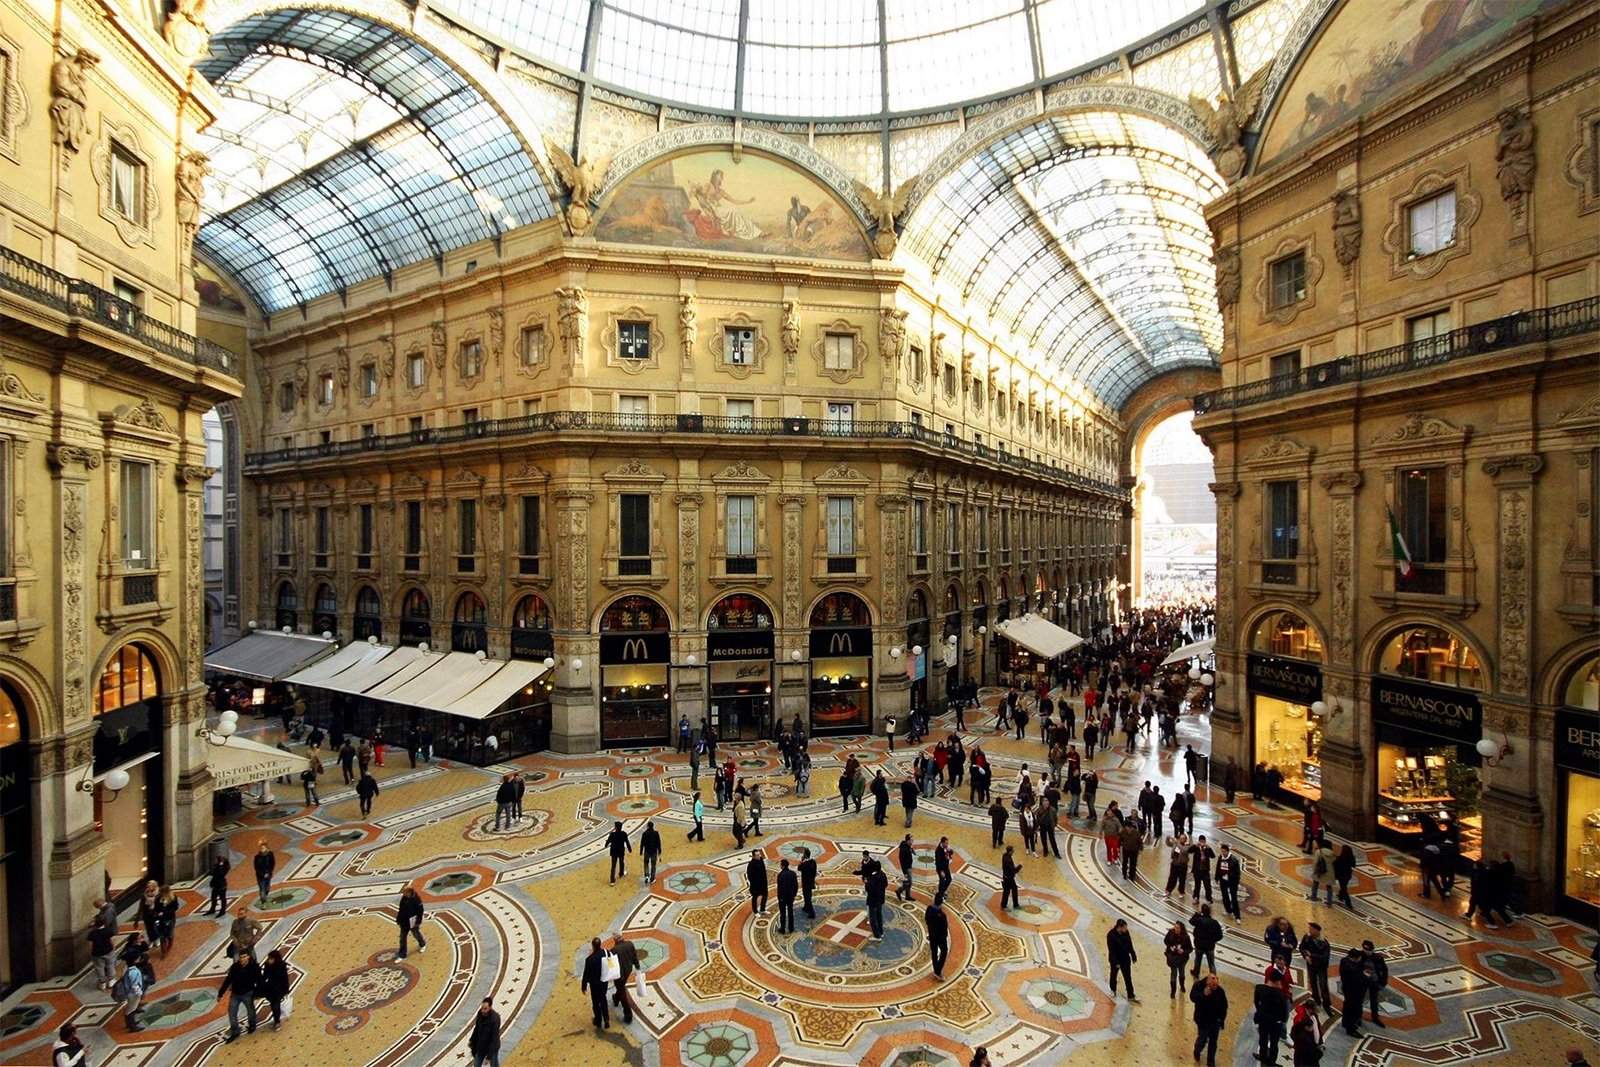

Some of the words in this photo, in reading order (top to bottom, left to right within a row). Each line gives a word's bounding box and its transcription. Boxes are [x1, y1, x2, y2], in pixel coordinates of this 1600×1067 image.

[713, 647, 769, 657] McDonald's
[1253, 663, 1318, 688] BERNASCONI
[1380, 690, 1473, 721] BERNASCONI
[215, 760, 278, 778] RISTORANTE
[249, 767, 292, 781] BISTROT
